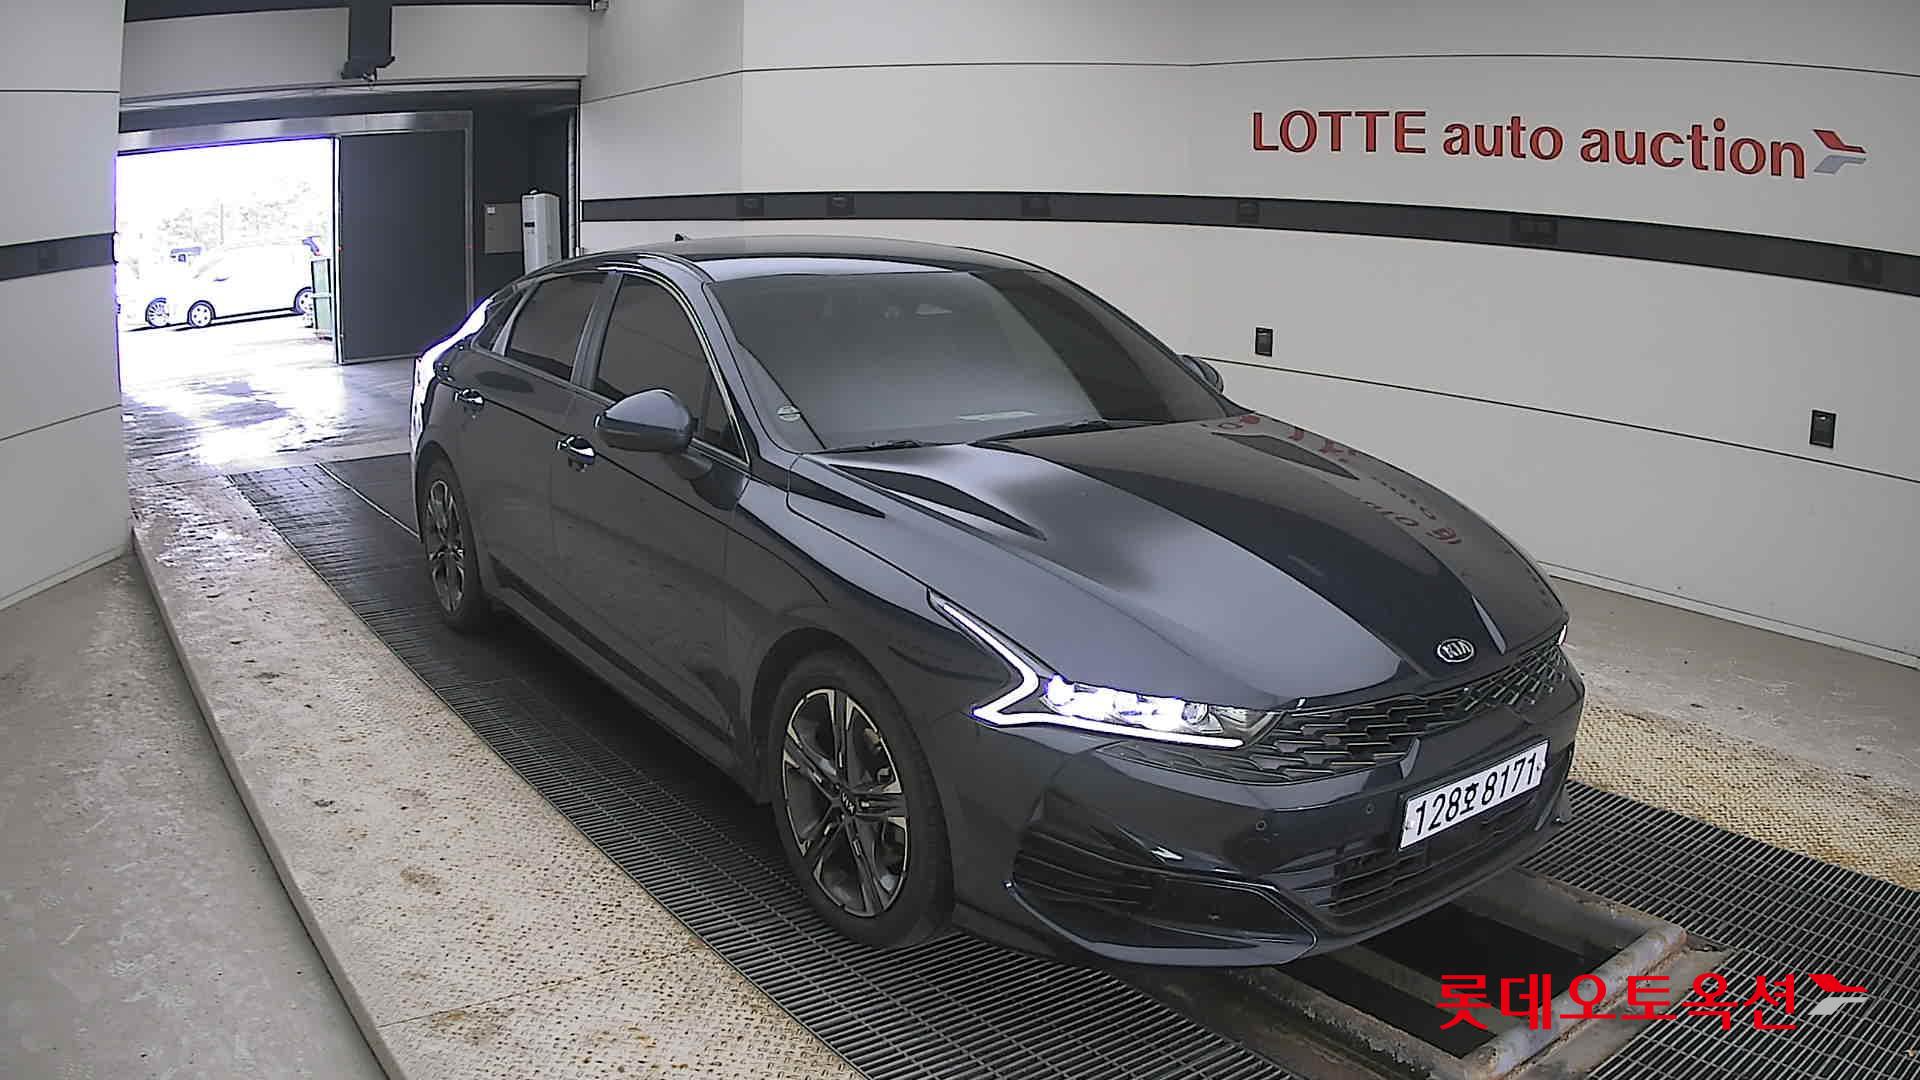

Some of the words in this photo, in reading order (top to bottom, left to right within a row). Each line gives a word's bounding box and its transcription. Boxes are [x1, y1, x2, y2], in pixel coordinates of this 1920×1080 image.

[1252, 111, 1427, 154] LOTTE
[1442, 116, 1566, 162] auto
[1581, 117, 1807, 177] auction
[1440, 640, 1472, 660] KIA
[1481, 751, 1537, 805] 8171
